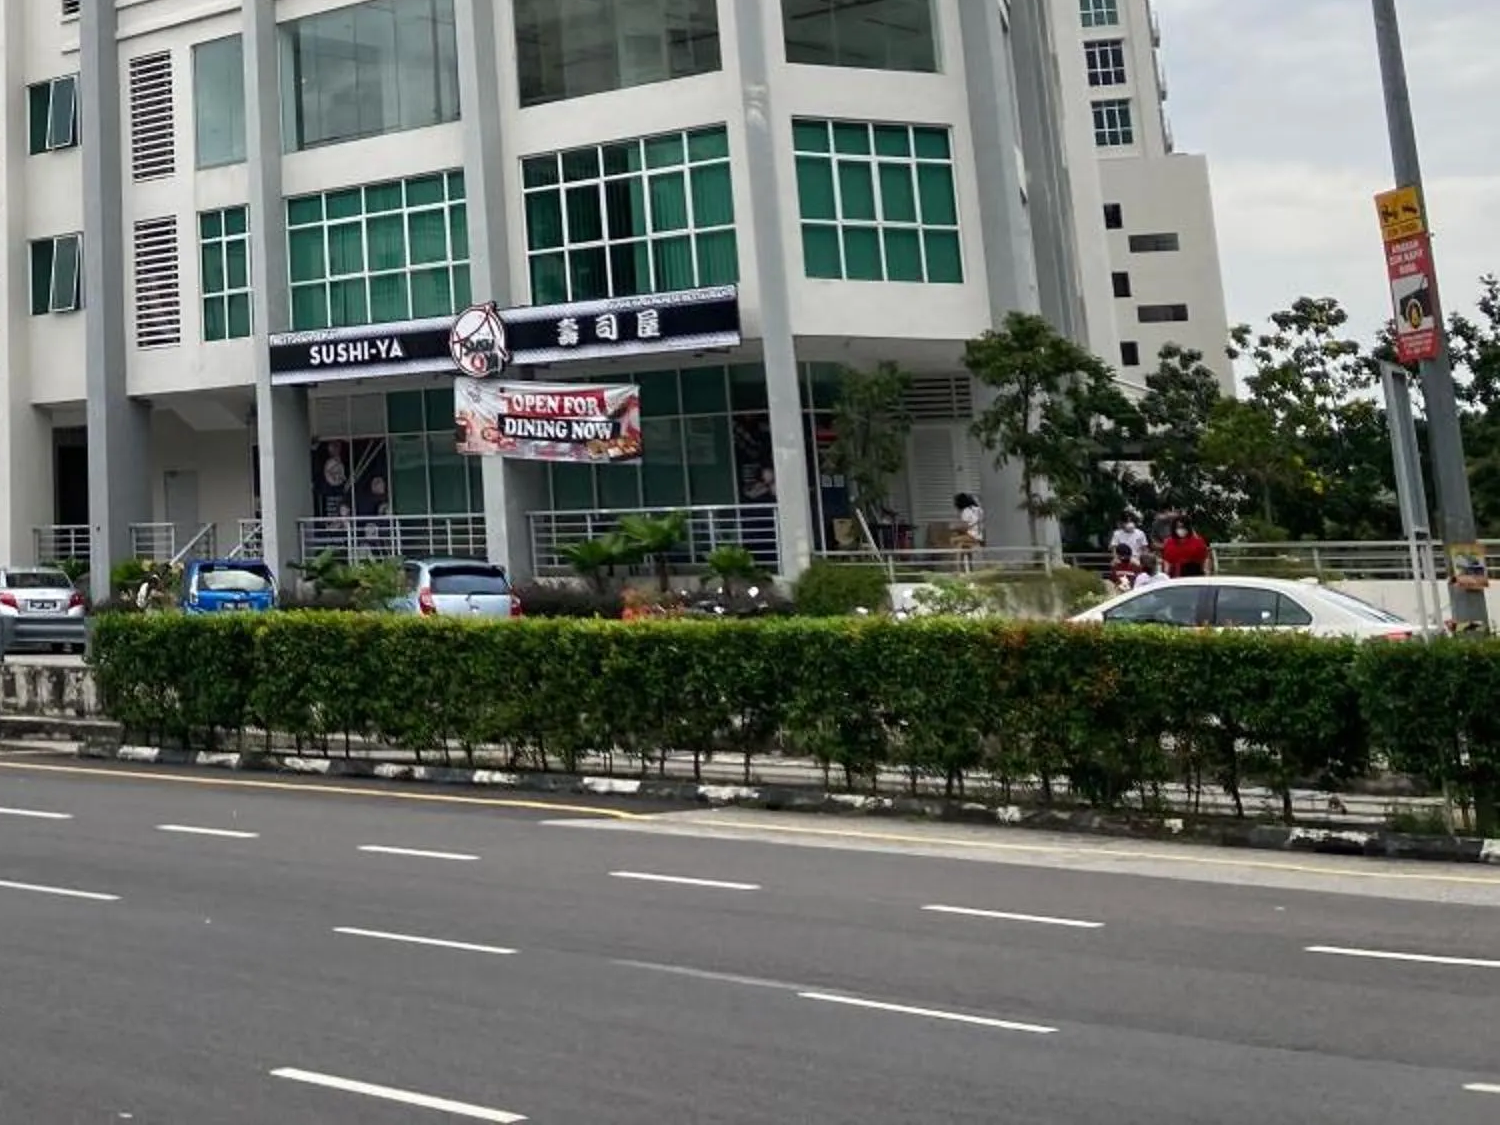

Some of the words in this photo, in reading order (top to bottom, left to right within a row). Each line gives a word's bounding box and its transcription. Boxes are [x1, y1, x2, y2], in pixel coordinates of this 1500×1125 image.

[309, 337, 403, 365] SUSHI-YA
[512, 394, 560, 414] OPEN
[563, 396, 600, 416] FOR
[504, 418, 568, 439] DINING
[571, 422, 613, 440] NOW
